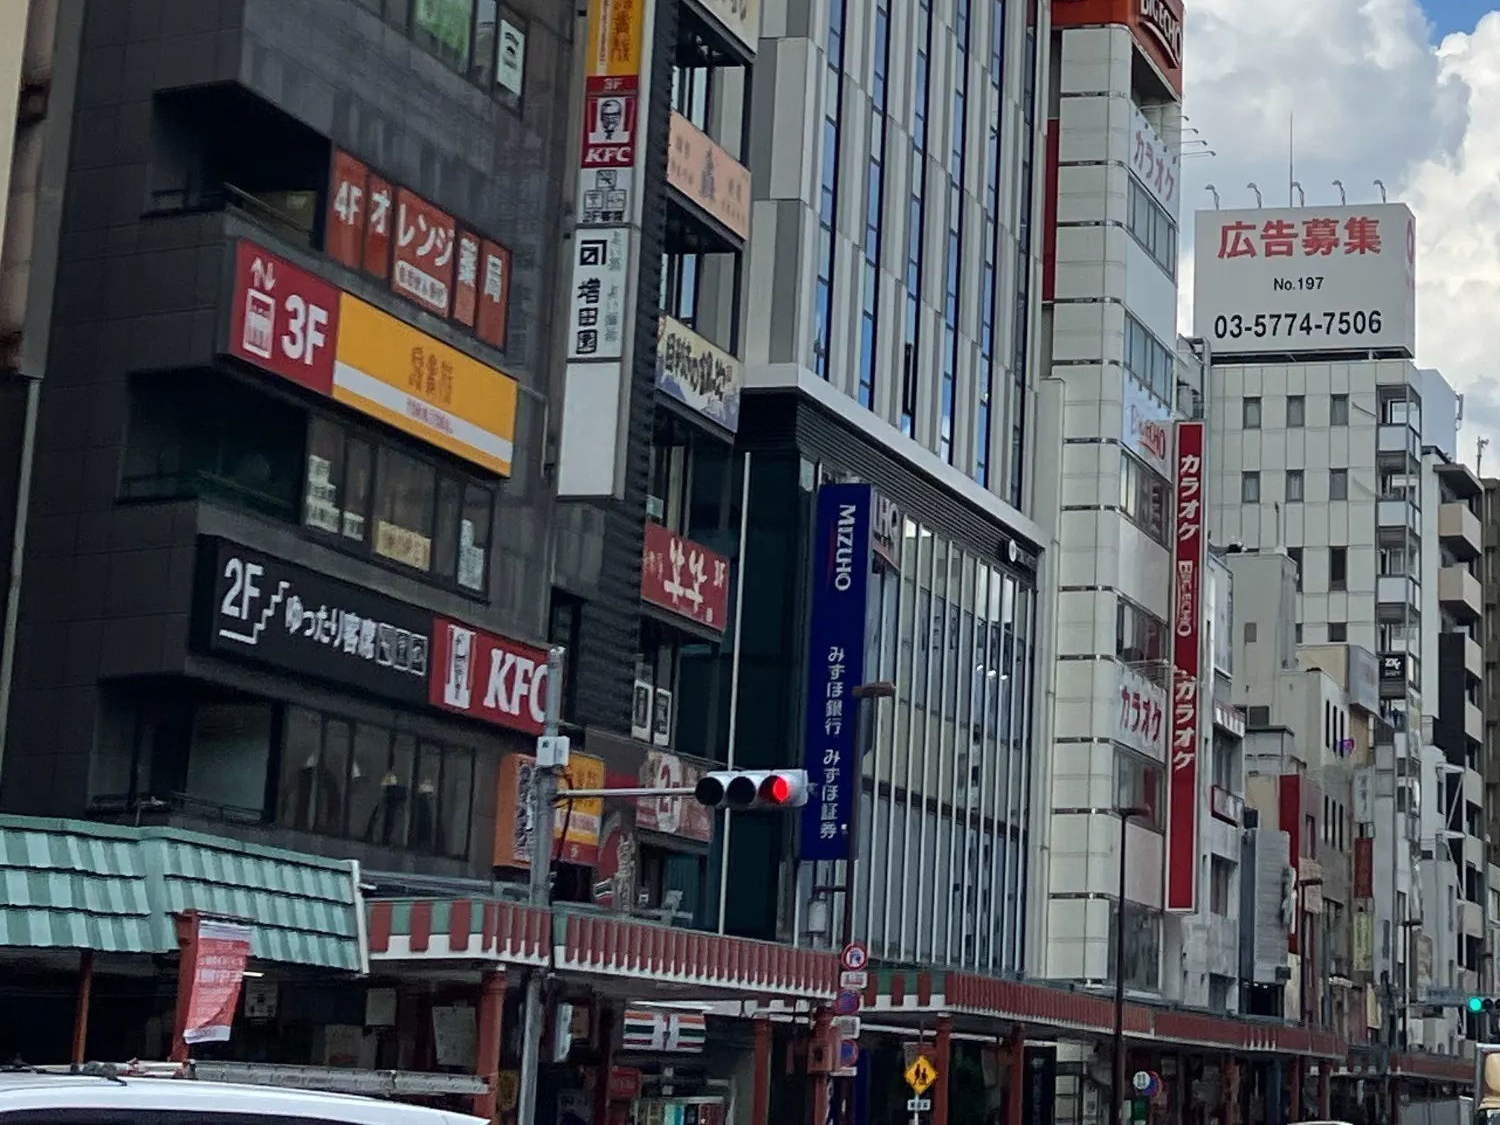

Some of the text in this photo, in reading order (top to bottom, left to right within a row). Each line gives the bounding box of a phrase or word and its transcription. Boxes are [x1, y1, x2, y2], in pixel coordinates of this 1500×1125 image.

[585, 147, 632, 163] KFC
[1133, 130, 1175, 202] カラオケ
[333, 180, 503, 304] 4F オレンジ薬局
[1217, 216, 1382, 259] 広告募集
[1273, 276, 1325, 291] No.197
[281, 294, 328, 365] 3F
[1213, 310, 1382, 339] 03-5774-7506
[1177, 453, 1200, 542] カラオケ
[834, 503, 857, 592] MIZUHO
[221, 557, 264, 620] 2F
[1176, 560, 1194, 637] BIG ECHO
[285, 595, 376, 660] ゆったり客席
[483, 648, 548, 723] KFC
[1119, 685, 1162, 744] カラオケ
[819, 645, 846, 840] みずほ銀行 みずほ証券
[1172, 676, 1197, 771] カラオケ
